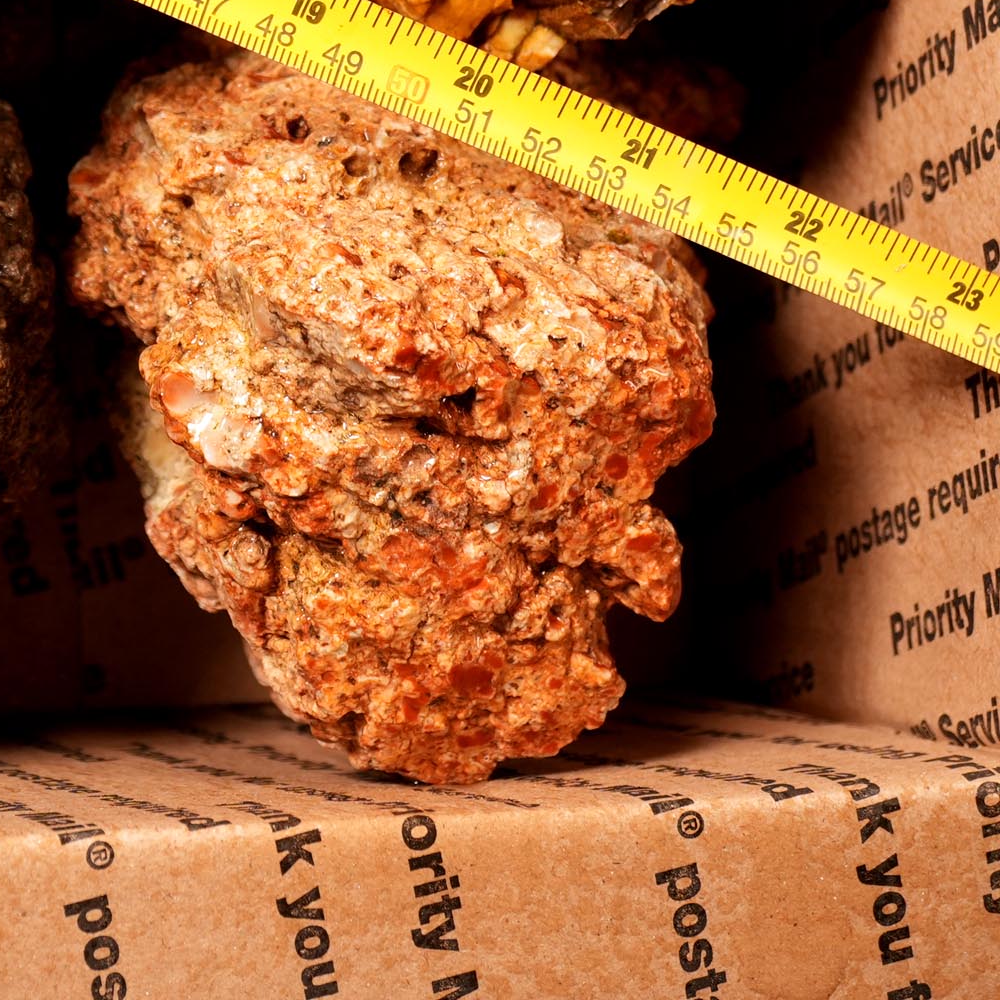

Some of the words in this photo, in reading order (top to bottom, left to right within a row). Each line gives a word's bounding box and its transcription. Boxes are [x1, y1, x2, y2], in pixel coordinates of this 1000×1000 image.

[873, 29, 956, 121] Priority
[255, 14, 297, 47] 48
[321, 43, 364, 76] 49
[388, 67, 428, 102] 50
[454, 100, 494, 133] 51
[521, 127, 562, 163] 52
[586, 155, 628, 191] 53
[651, 183, 692, 220] 54
[716, 212, 758, 247] 55
[780, 240, 821, 275] 56
[844, 268, 886, 300] 57
[908, 296, 947, 330] 58
[453, 65, 495, 98] 20
[620, 138, 658, 170] 21
[784, 210, 824, 243] 22
[946, 281, 984, 311] 23
[831, 332, 870, 389] you
[835, 497, 921, 573] postage
[890, 588, 975, 656] Priority
[216, 801, 321, 876] Thank
[276, 885, 339, 1000] you
[779, 763, 901, 843] Thank
[856, 853, 914, 966] you
[921, 754, 1000, 914] Prio
[655, 862, 728, 1000] post
